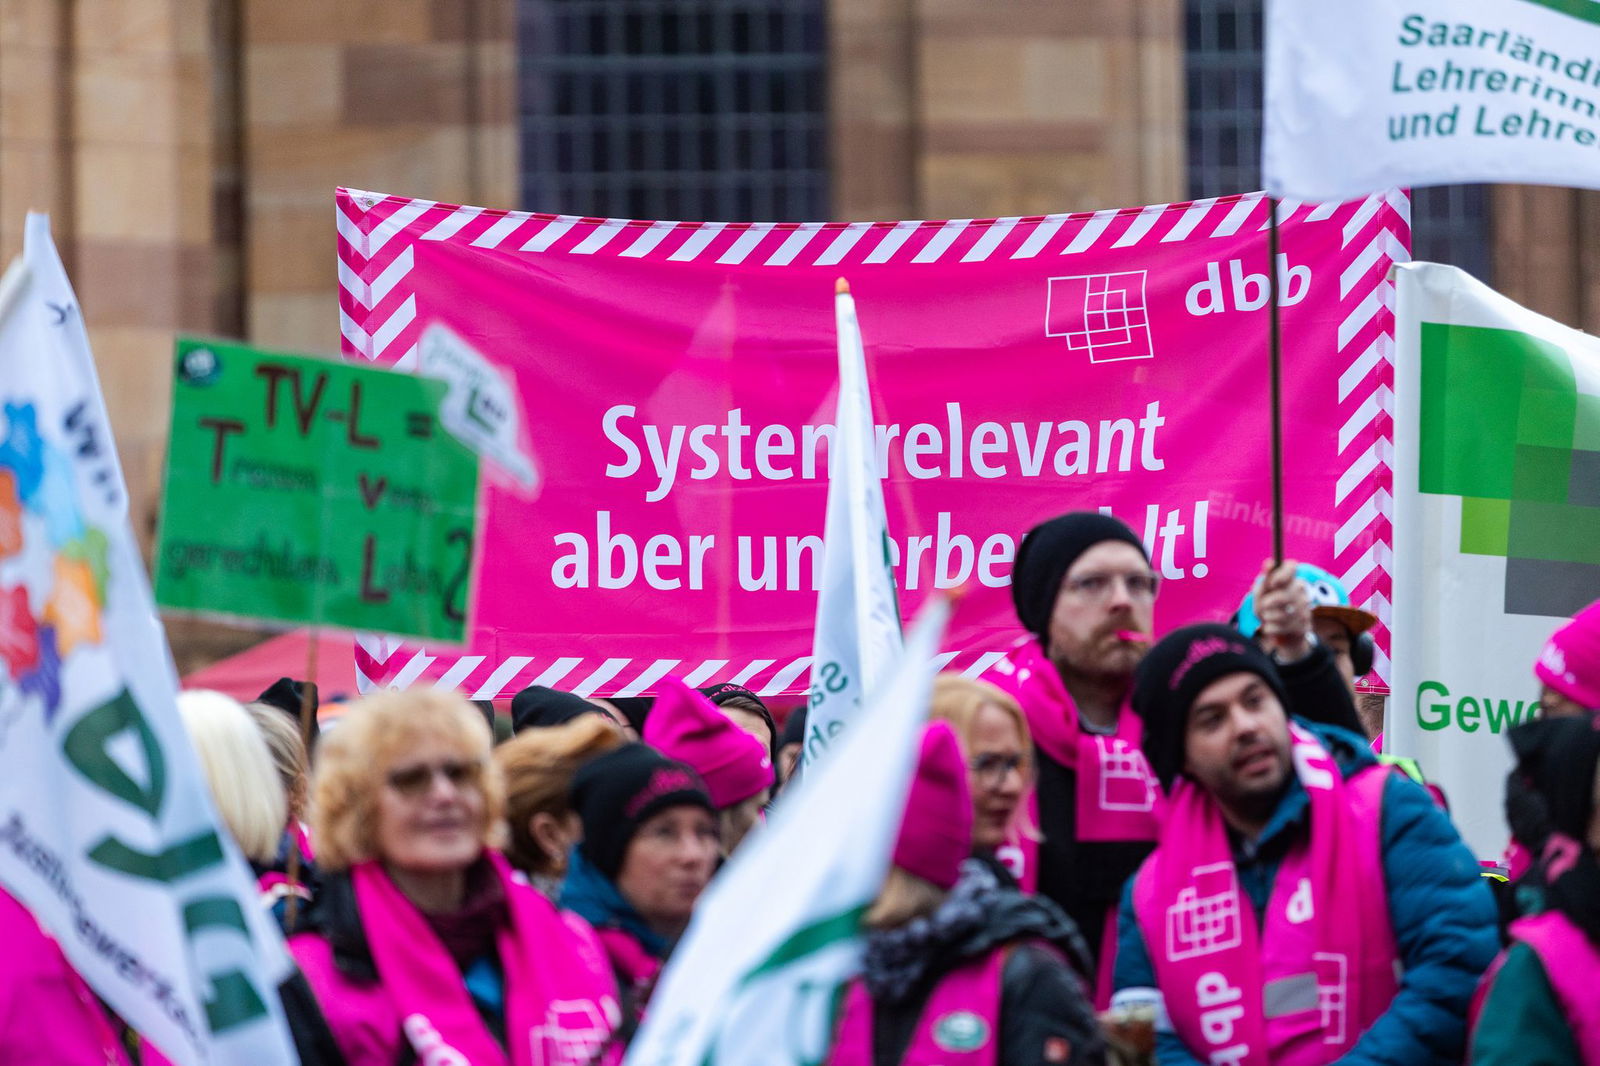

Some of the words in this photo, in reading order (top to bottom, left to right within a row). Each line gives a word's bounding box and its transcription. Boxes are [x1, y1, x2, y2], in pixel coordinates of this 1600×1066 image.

[1392, 60, 1600, 118] Lehrerinn
[1388, 105, 1459, 141] und
[1474, 105, 1600, 147] Lehre
[1185, 253, 1312, 316] dbb
[255, 364, 381, 449] TV-L
[551, 511, 714, 589] aber
[738, 500, 1209, 591] unrbelt!
[1207, 490, 1373, 551] Einkmmn
